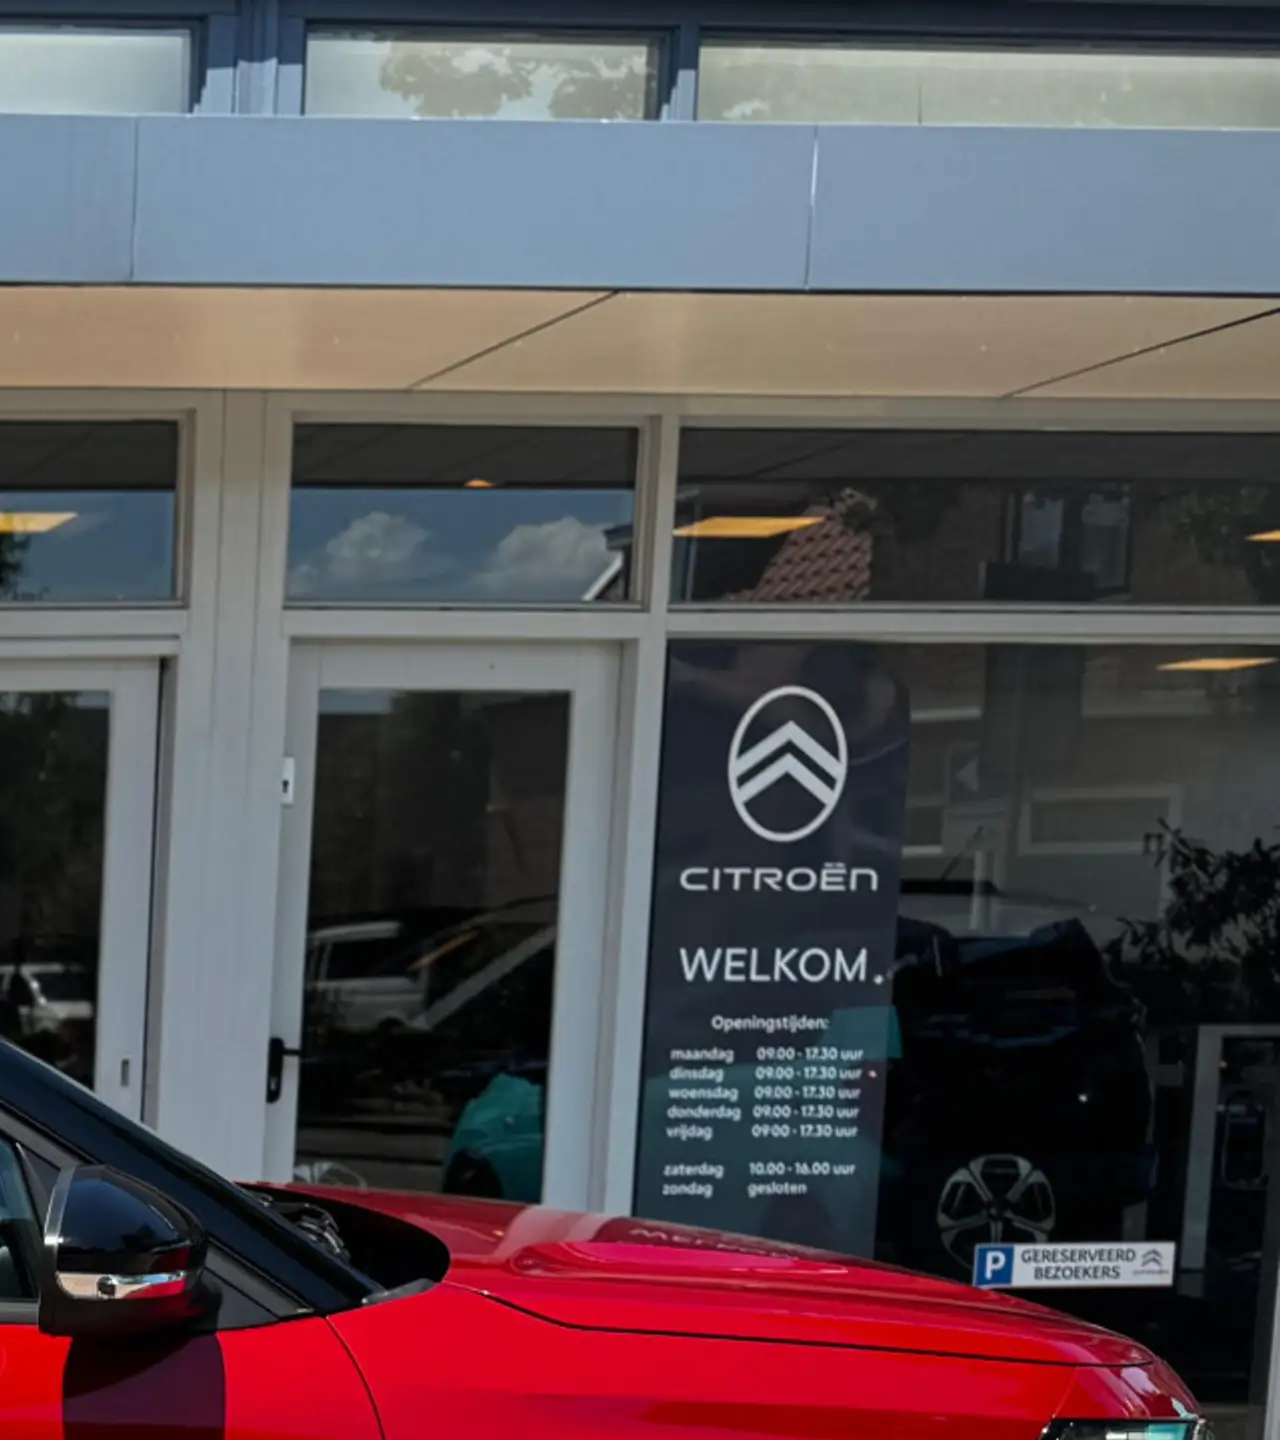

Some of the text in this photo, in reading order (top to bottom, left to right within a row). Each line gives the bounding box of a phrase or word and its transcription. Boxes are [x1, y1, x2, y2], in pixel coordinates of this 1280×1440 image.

[711, 1015, 830, 1034] Openingstijden:
[669, 1046, 734, 1064] maandag
[804, 1046, 838, 1060] 17.30
[840, 1049, 864, 1061] uur
[669, 1066, 724, 1083] dinsdag
[803, 1066, 837, 1080] 17.30
[838, 1068, 863, 1080] uur
[668, 1086, 739, 1103] woensdag
[801, 1085, 835, 1099] 17.30
[837, 1088, 862, 1100] uur
[666, 1104, 742, 1122] donderdag
[800, 1104, 834, 1118] 17.30
[836, 1107, 860, 1118] uur
[666, 1124, 713, 1141] vrijdag
[799, 1124, 833, 1137] 17.30
[834, 1126, 859, 1137] uur
[662, 1162, 724, 1179] zaterdag
[795, 1162, 830, 1175] 16.00
[832, 1164, 856, 1175] uur
[662, 1182, 807, 1198] zondag gesloten
[1021, 1247, 1136, 1263] GERESERVEERD
[985, 1250, 1007, 1281] P
[1034, 1265, 1121, 1281] BEZOEKERS
